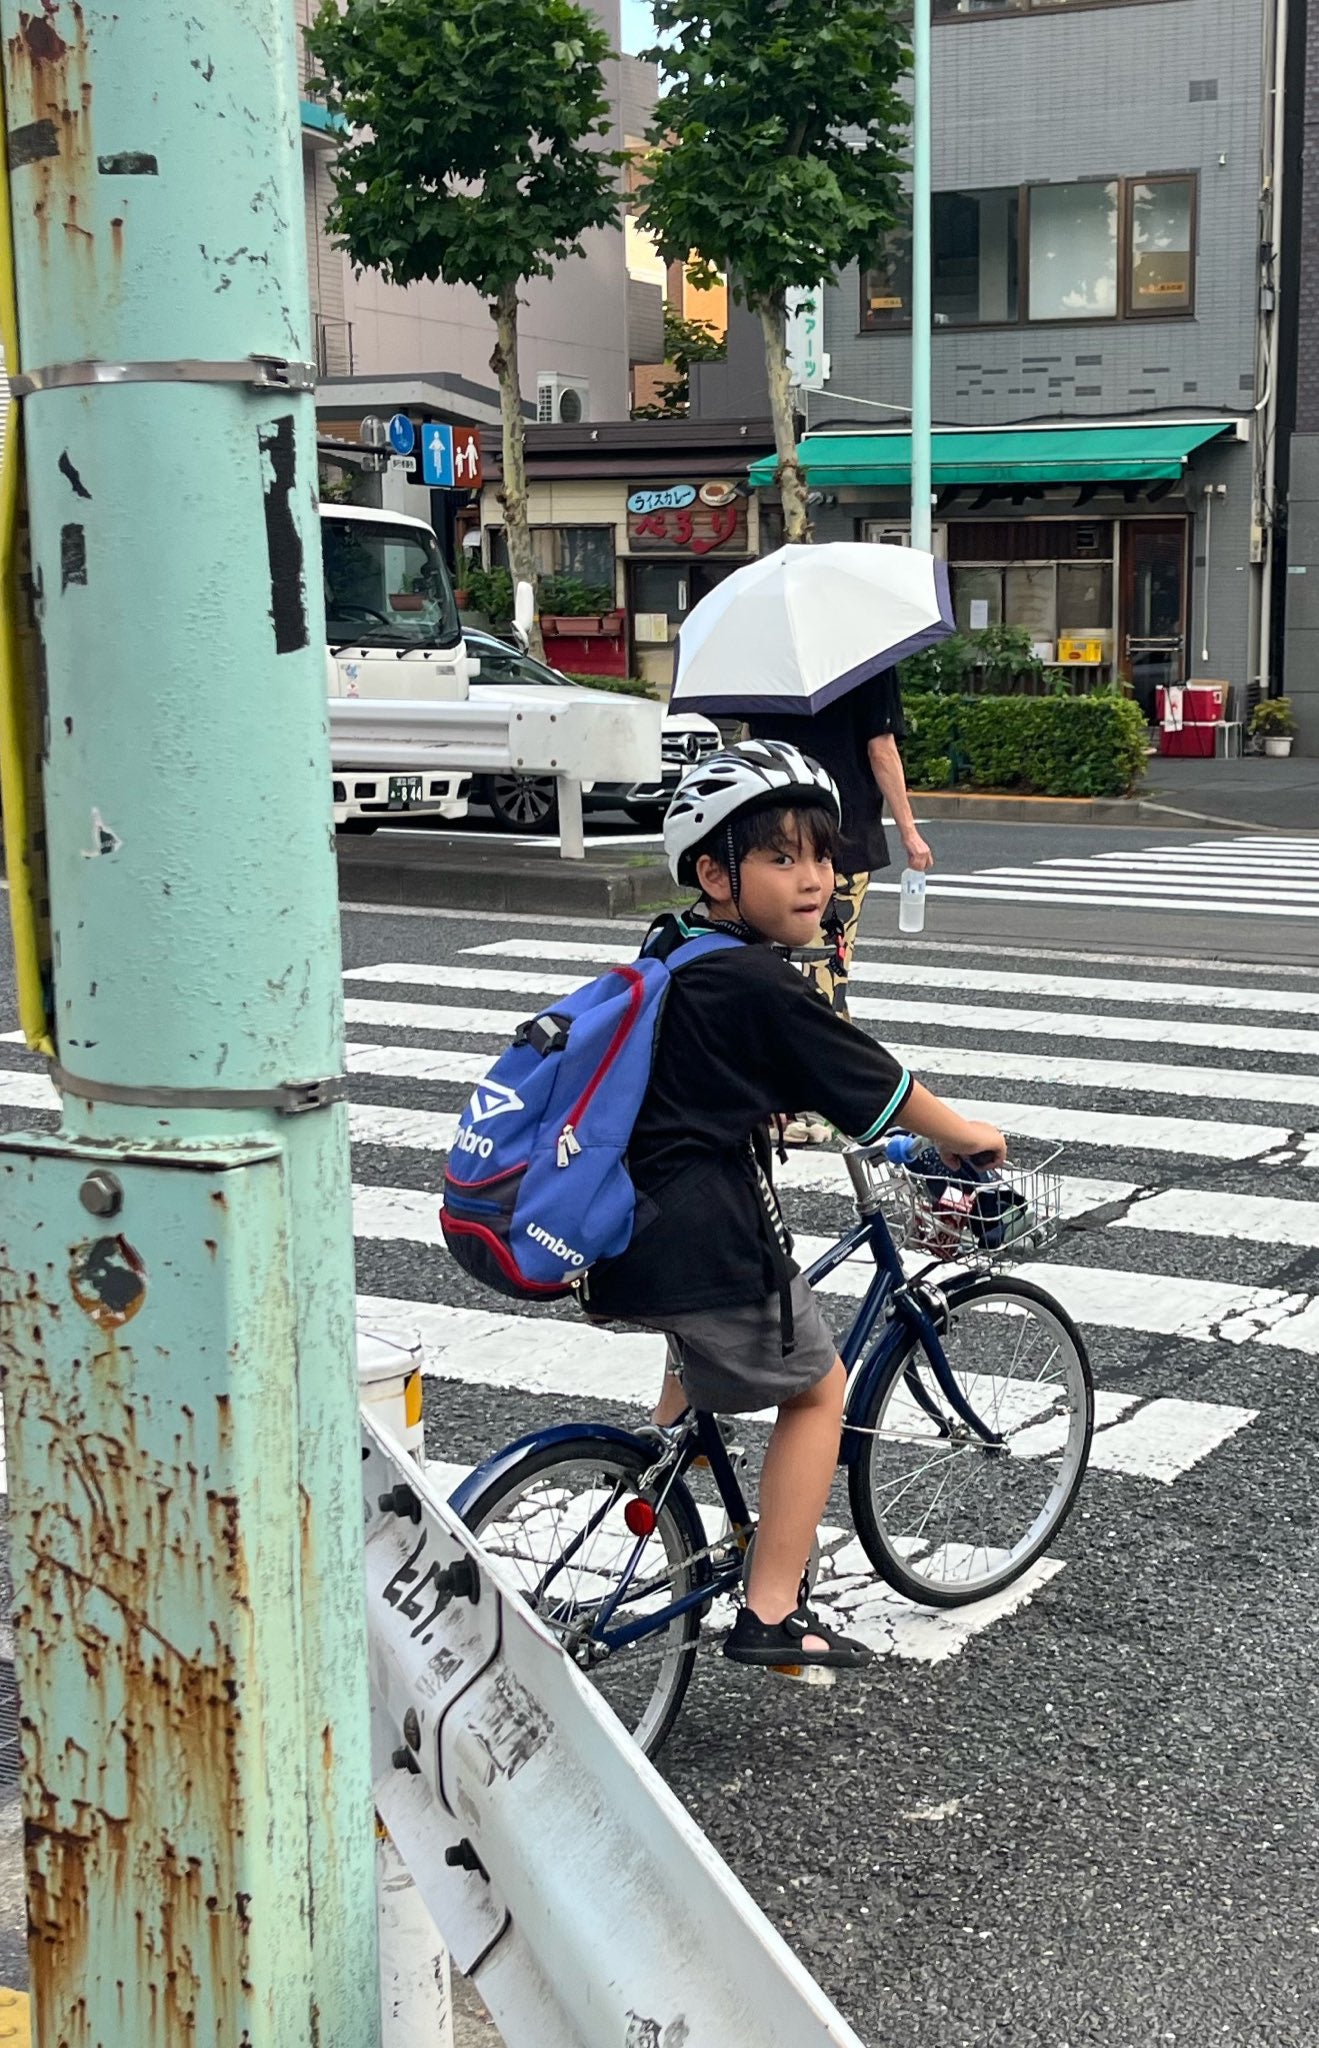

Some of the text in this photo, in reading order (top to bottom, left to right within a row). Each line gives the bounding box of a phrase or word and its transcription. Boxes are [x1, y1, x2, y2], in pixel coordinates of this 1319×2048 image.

[635, 490, 691, 511] ライスカレー
[635, 505, 737, 555] ぺろり
[526, 1222, 584, 1266] umbro
